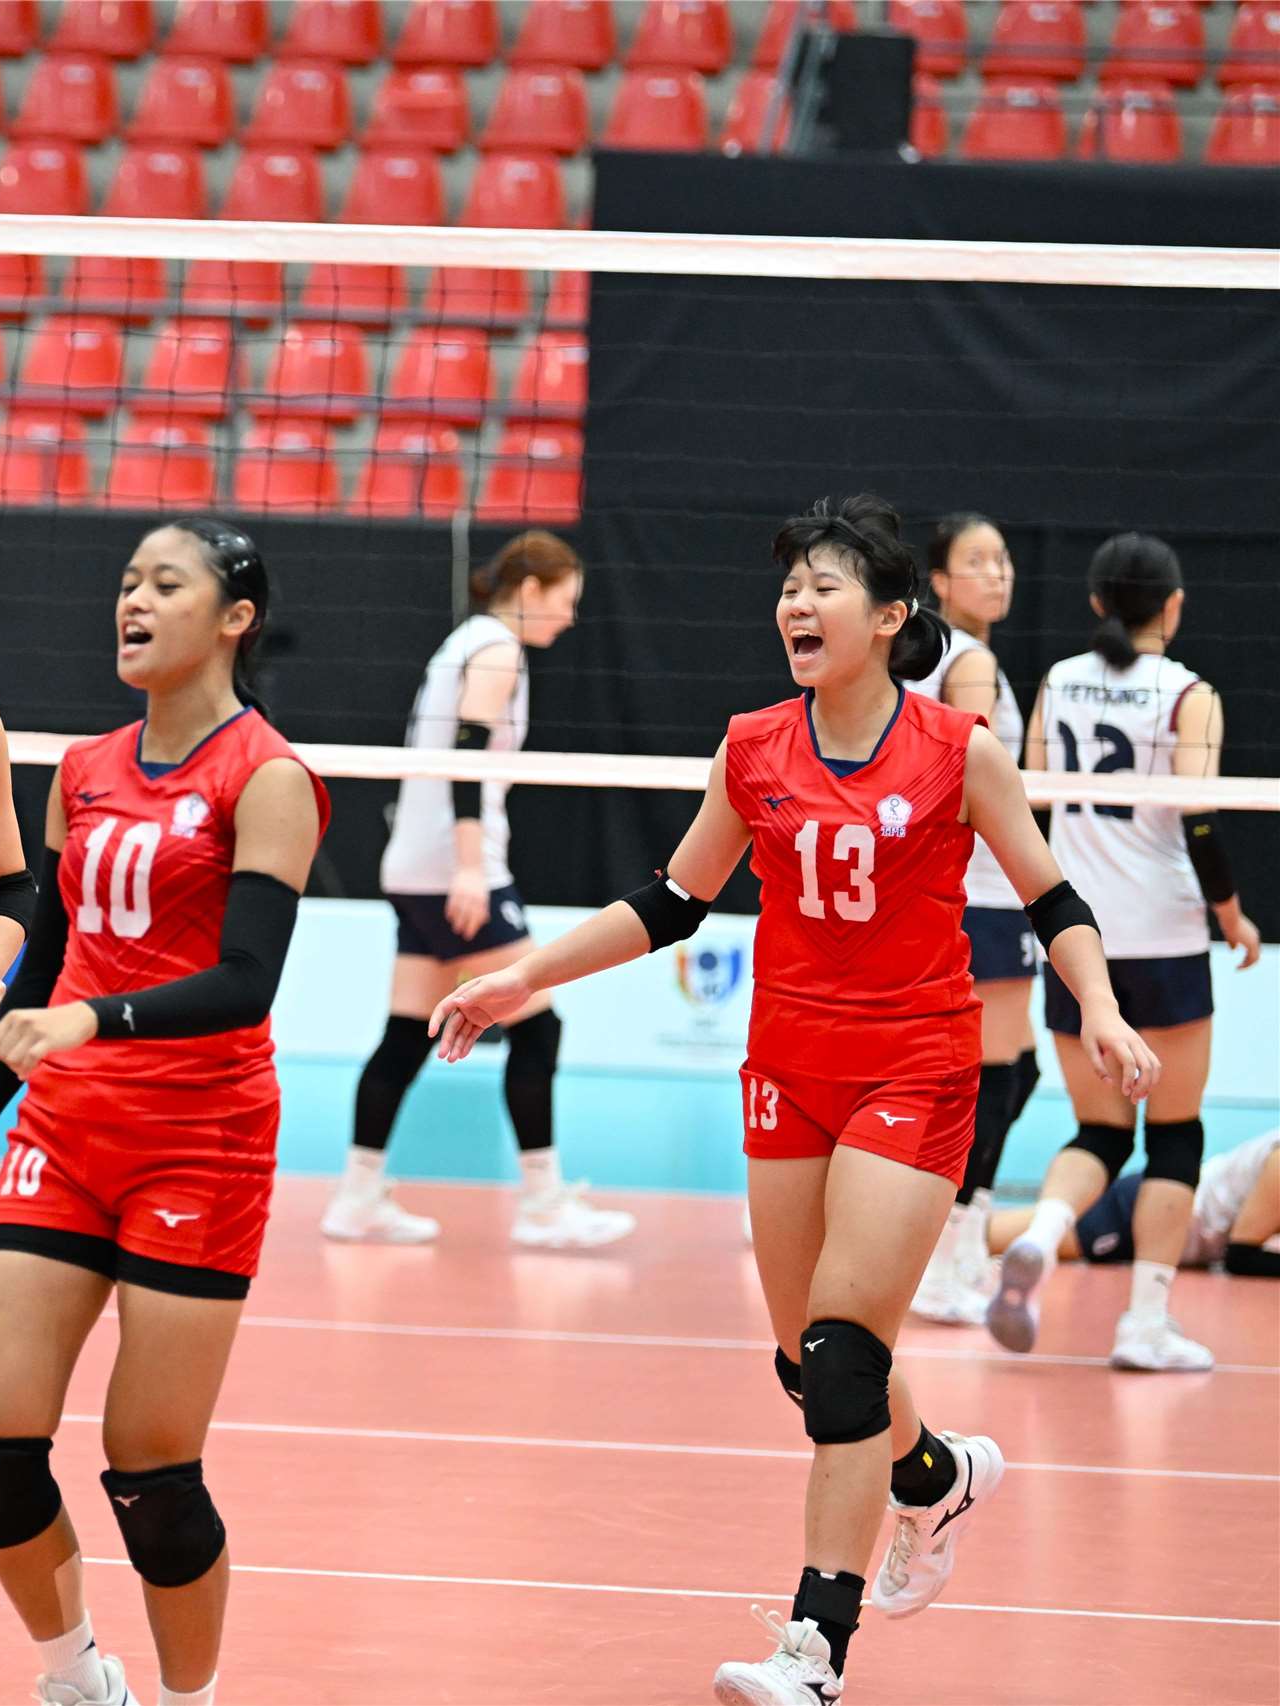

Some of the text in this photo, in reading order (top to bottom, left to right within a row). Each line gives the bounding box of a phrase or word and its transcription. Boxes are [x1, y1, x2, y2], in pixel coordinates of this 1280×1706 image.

[76, 816, 162, 939] 10
[794, 820, 876, 922] 13
[748, 1077, 779, 1131] 13
[0, 1145, 48, 1196] 10
